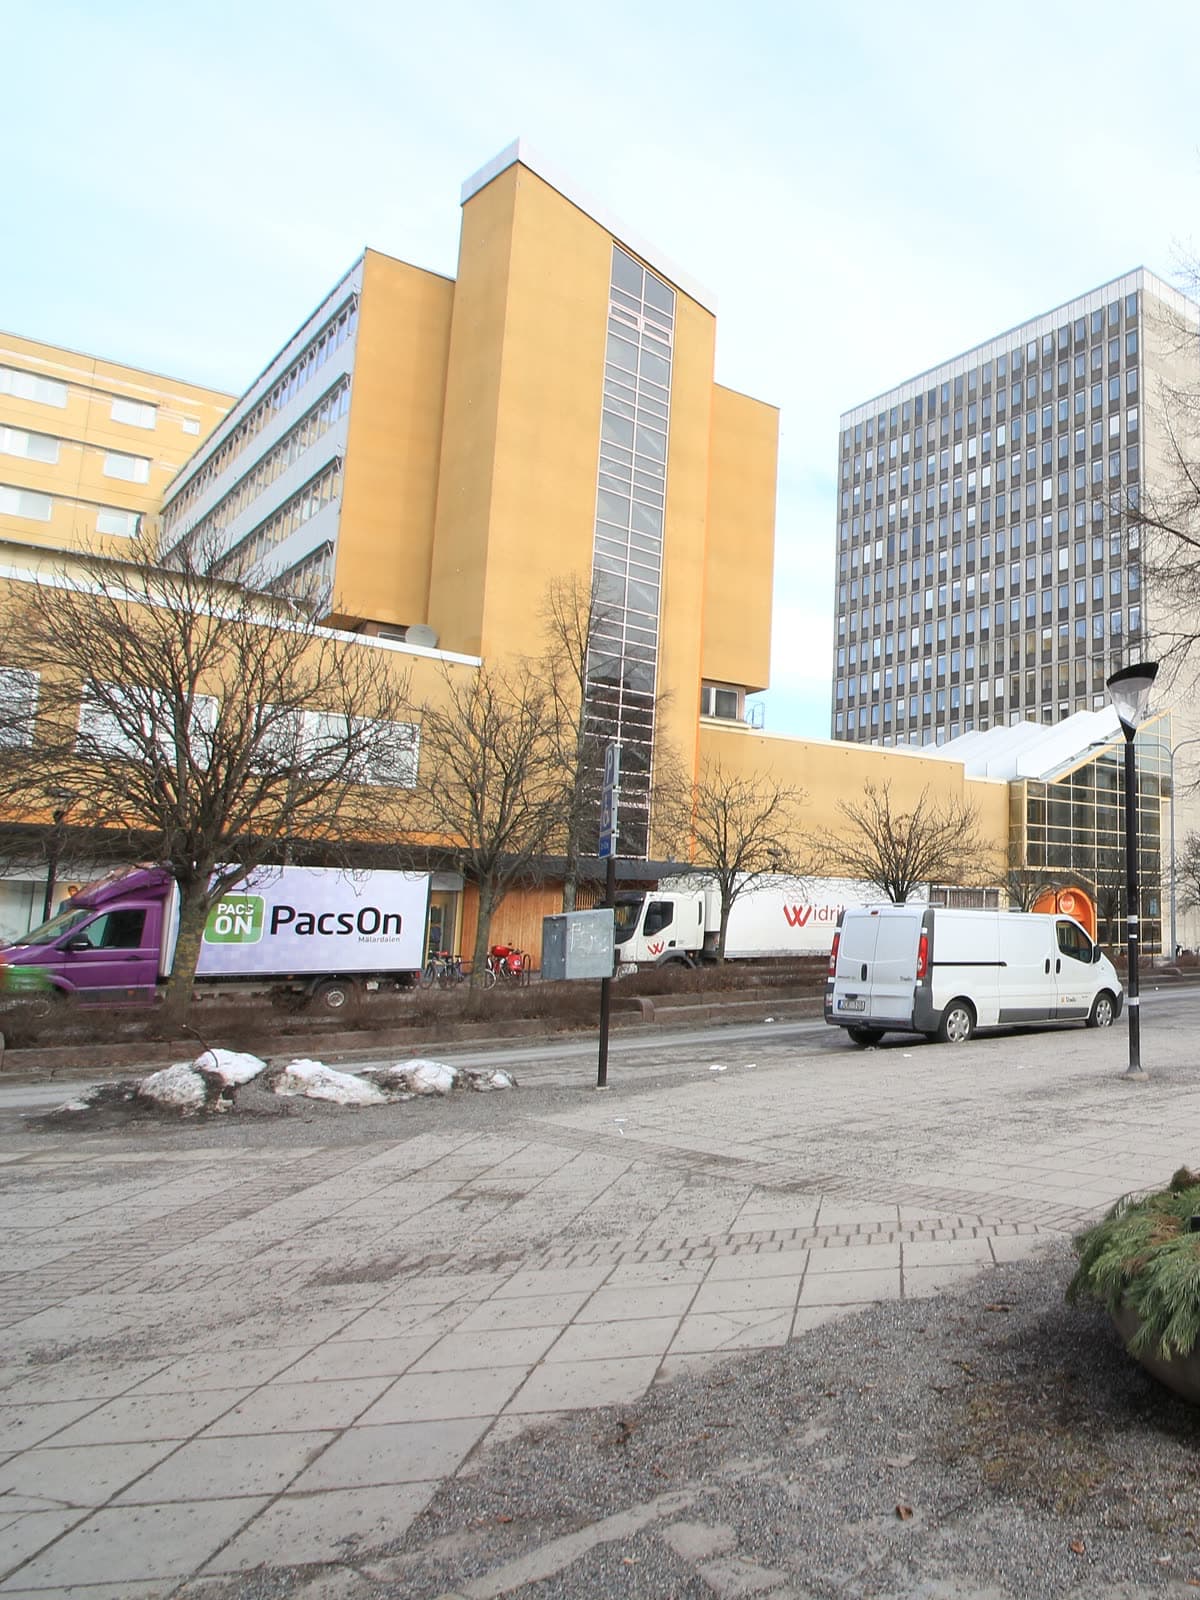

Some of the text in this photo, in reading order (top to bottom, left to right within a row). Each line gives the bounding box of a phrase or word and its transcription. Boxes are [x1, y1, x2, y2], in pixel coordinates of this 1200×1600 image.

[217, 903, 254, 916] PACS
[214, 916, 252, 935] ON
[270, 905, 402, 935] PacsOn
[358, 935, 401, 943] Mälardalen
